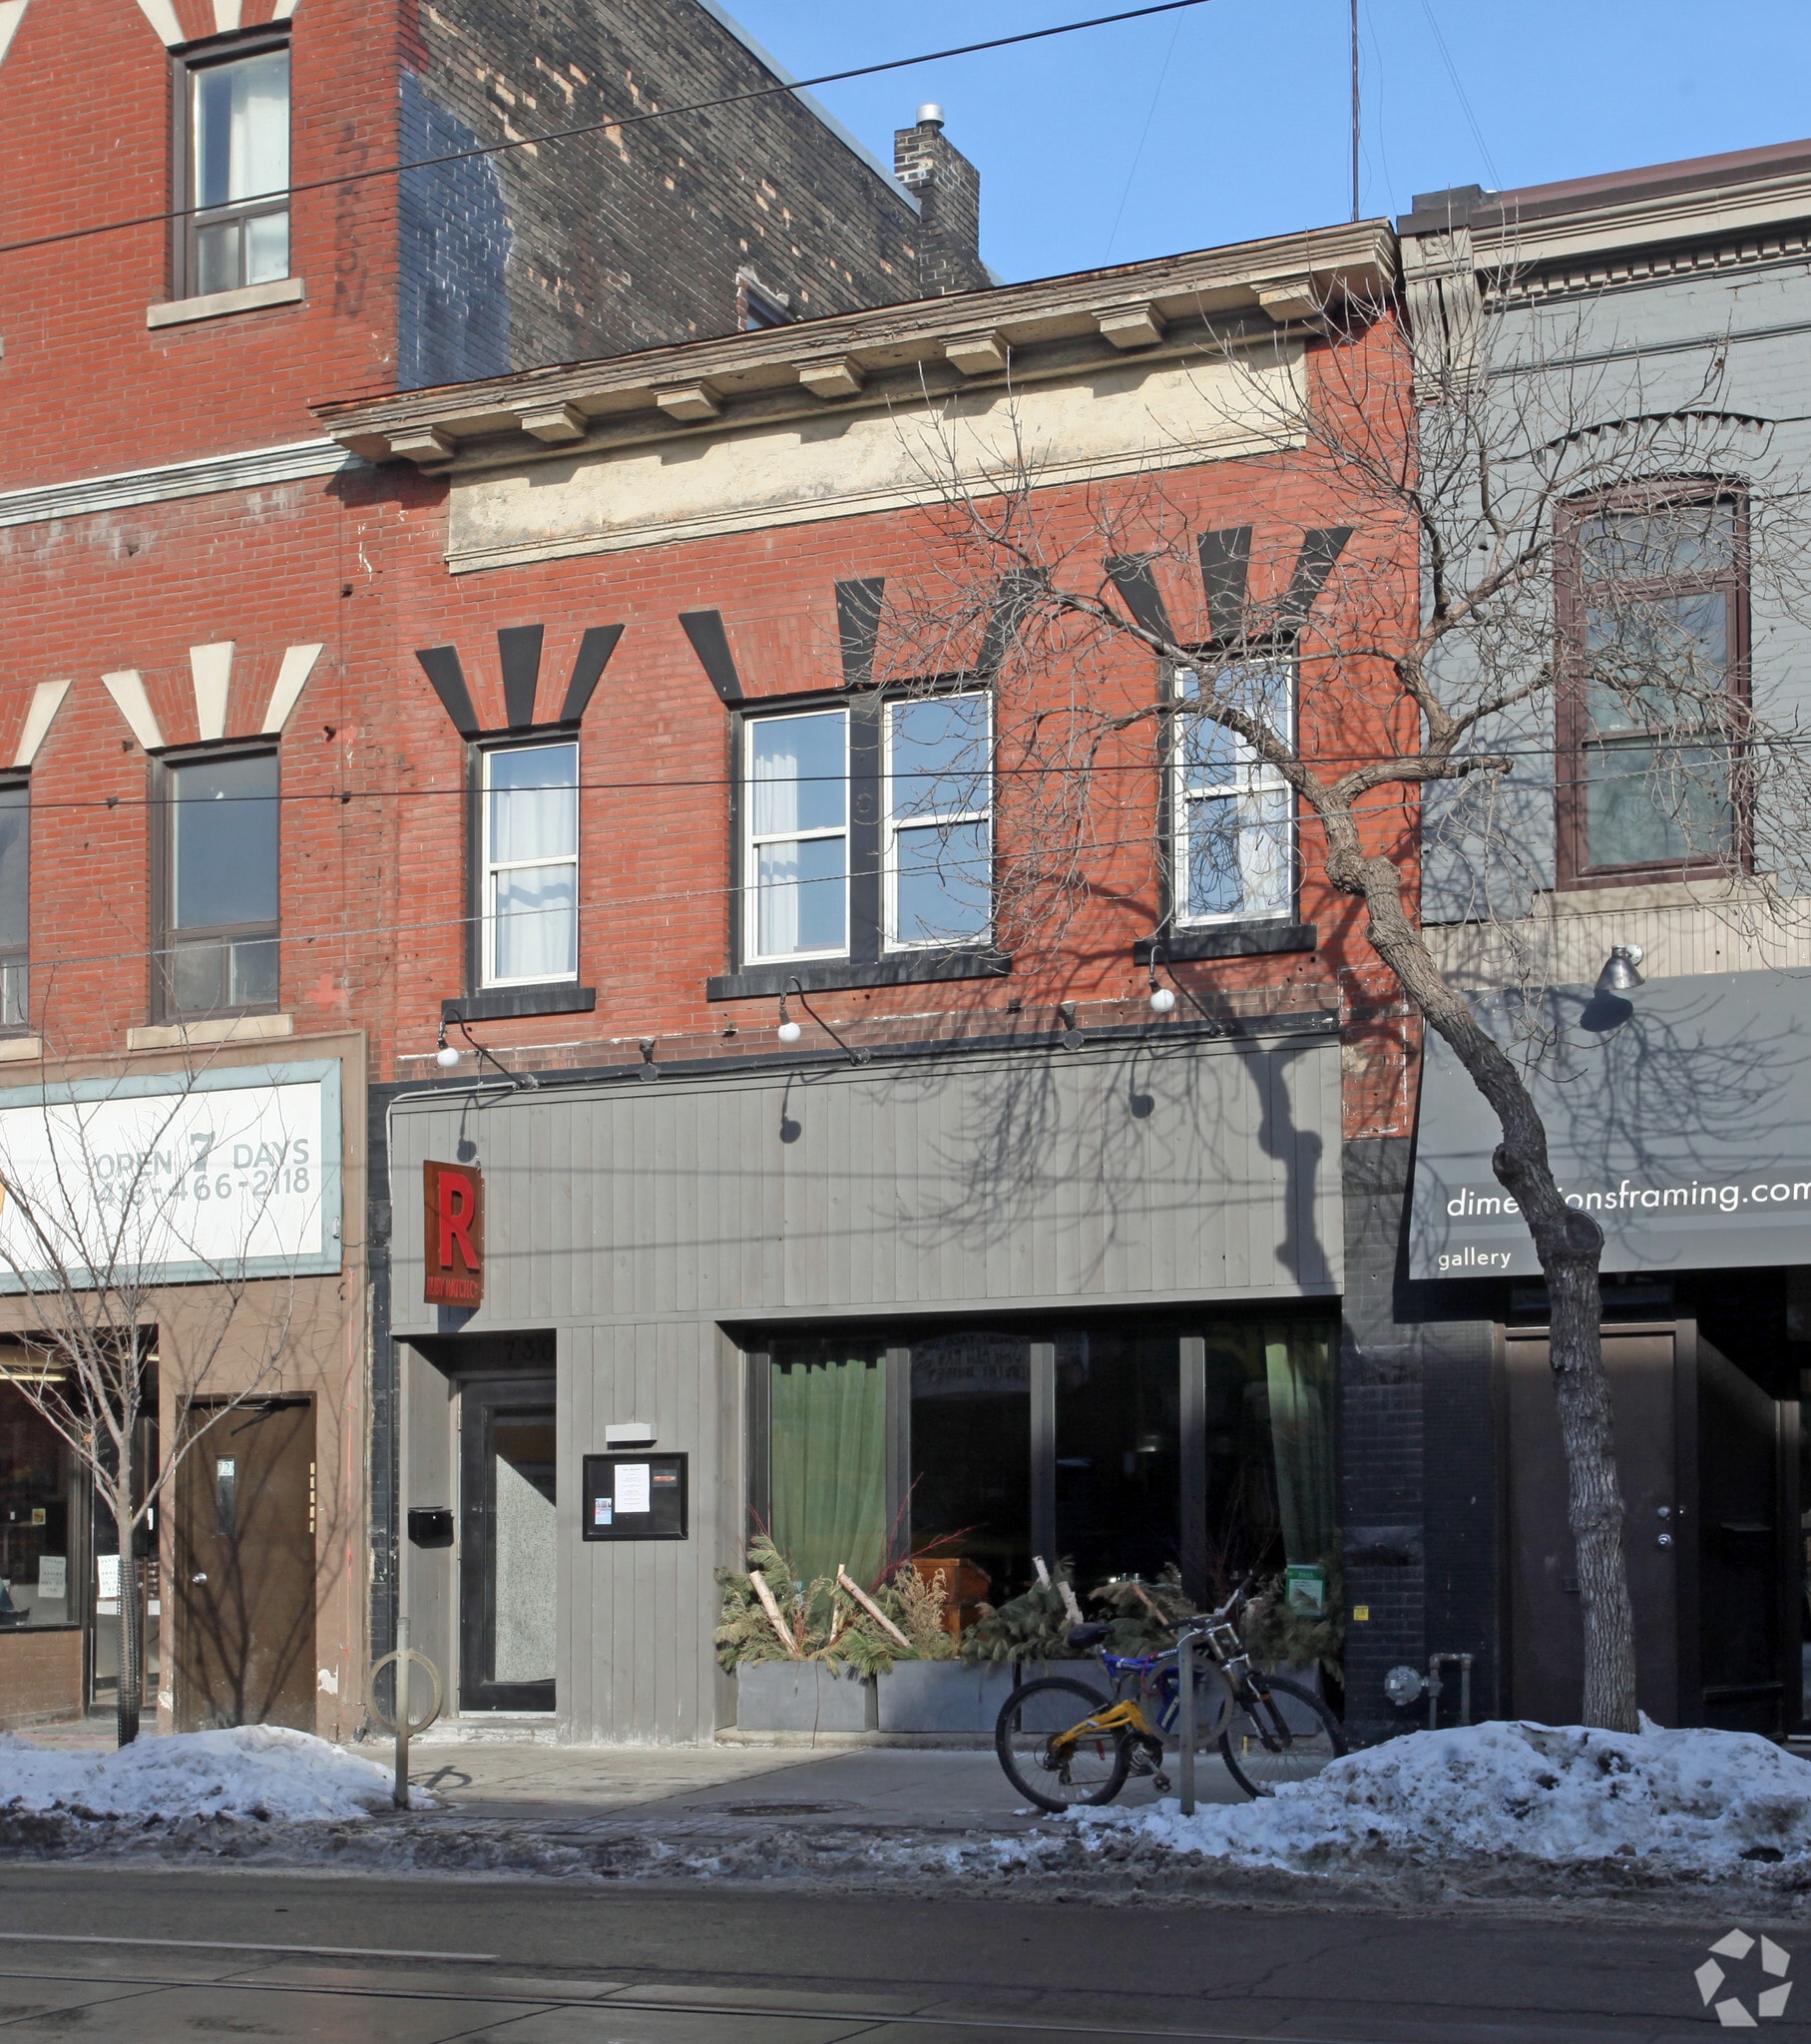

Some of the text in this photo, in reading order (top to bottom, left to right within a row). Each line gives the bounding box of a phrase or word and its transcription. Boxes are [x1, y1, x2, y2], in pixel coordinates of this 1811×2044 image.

[97, 1132, 309, 1180] OPEN 7 DAYS
[439, 1171, 480, 1270] R
[1438, 1247, 1512, 1271] gallery
